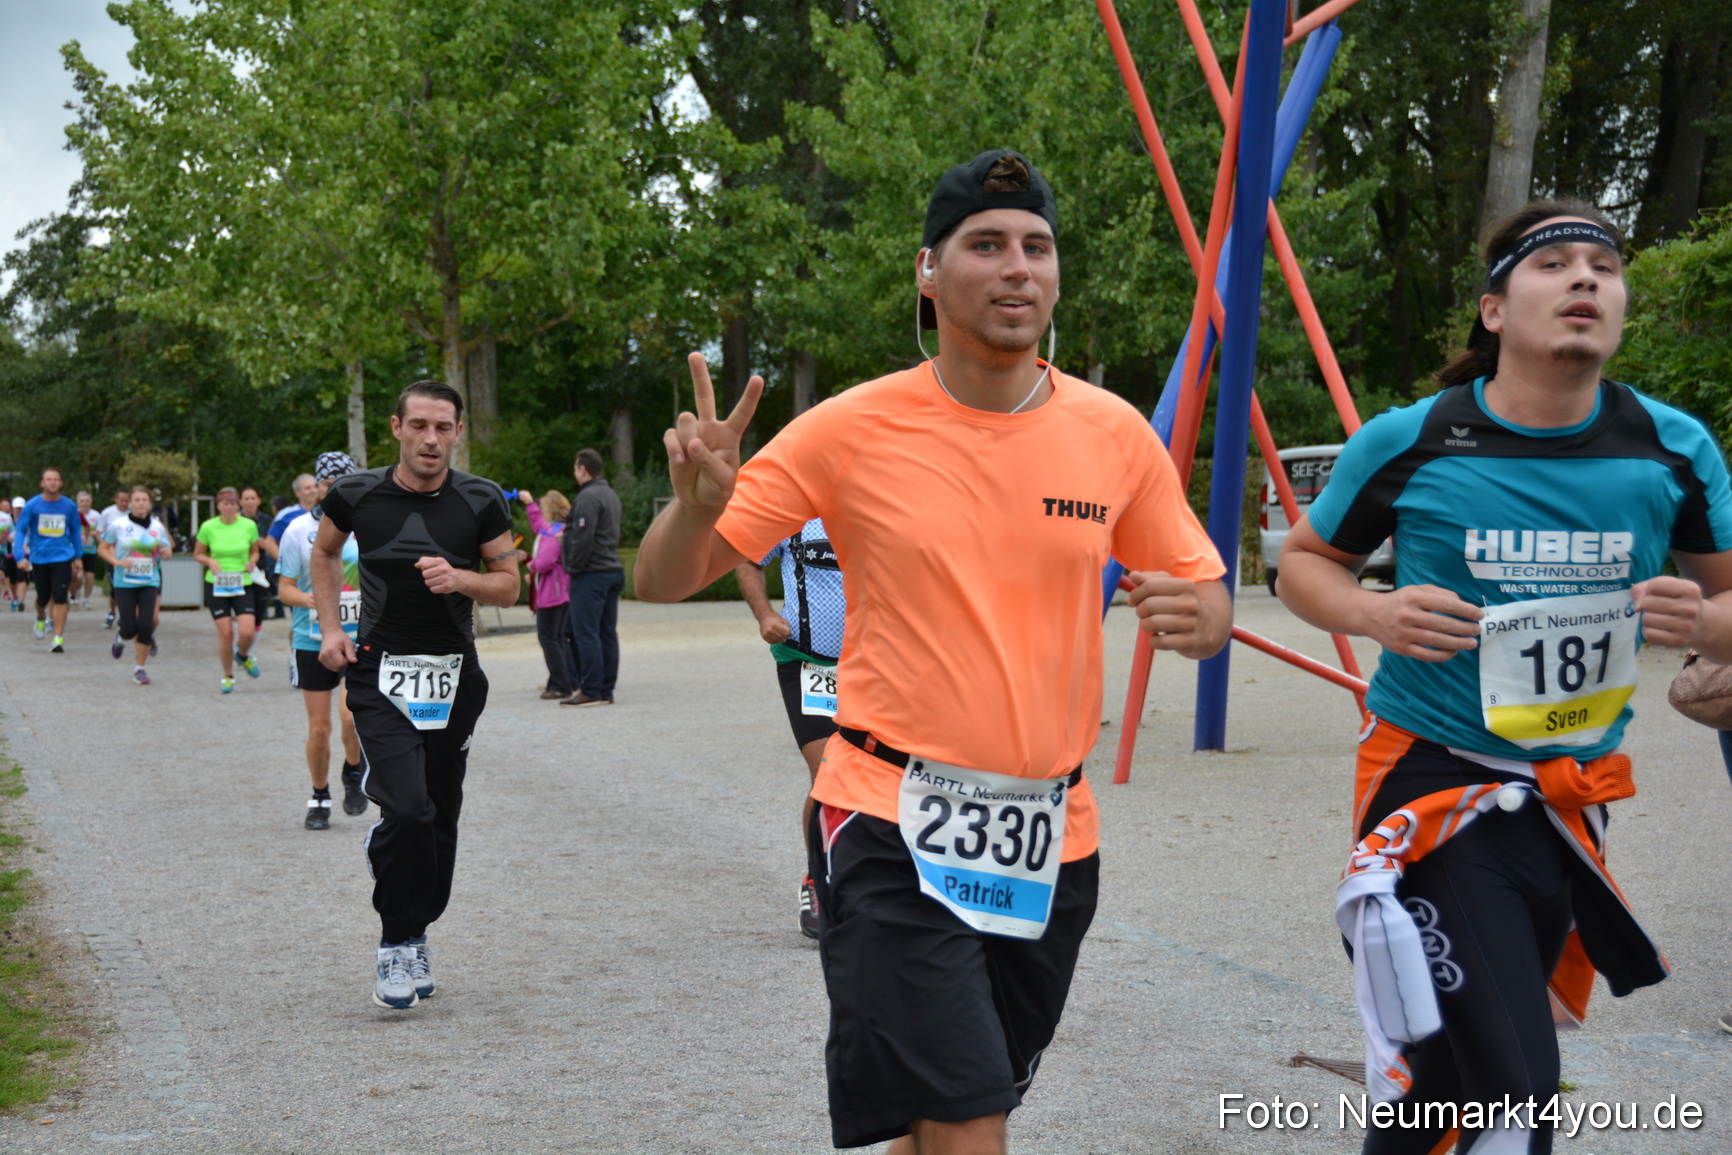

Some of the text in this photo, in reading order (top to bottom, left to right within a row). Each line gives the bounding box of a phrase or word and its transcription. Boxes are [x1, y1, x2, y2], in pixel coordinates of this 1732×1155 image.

[1445, 439, 1477, 448] erima
[1042, 497, 1107, 525] THULE
[1465, 529, 1633, 563] HUBER
[1501, 566, 1624, 578] TECHNOLOGY
[1500, 583, 1622, 593] WASTE WATER Solutions
[1485, 608, 1621, 635] PARTL Neumarkt
[383, 660, 412, 669] PARTL
[1520, 631, 1612, 695] 181
[389, 671, 451, 699] 2116
[809, 673, 837, 695] 28
[826, 700, 838, 711] Pe
[1546, 708, 1588, 732] Sven
[909, 769, 1045, 803] PARTL Neumarkt
[916, 795, 1052, 872] 2330
[944, 875, 1015, 910] Patrick
